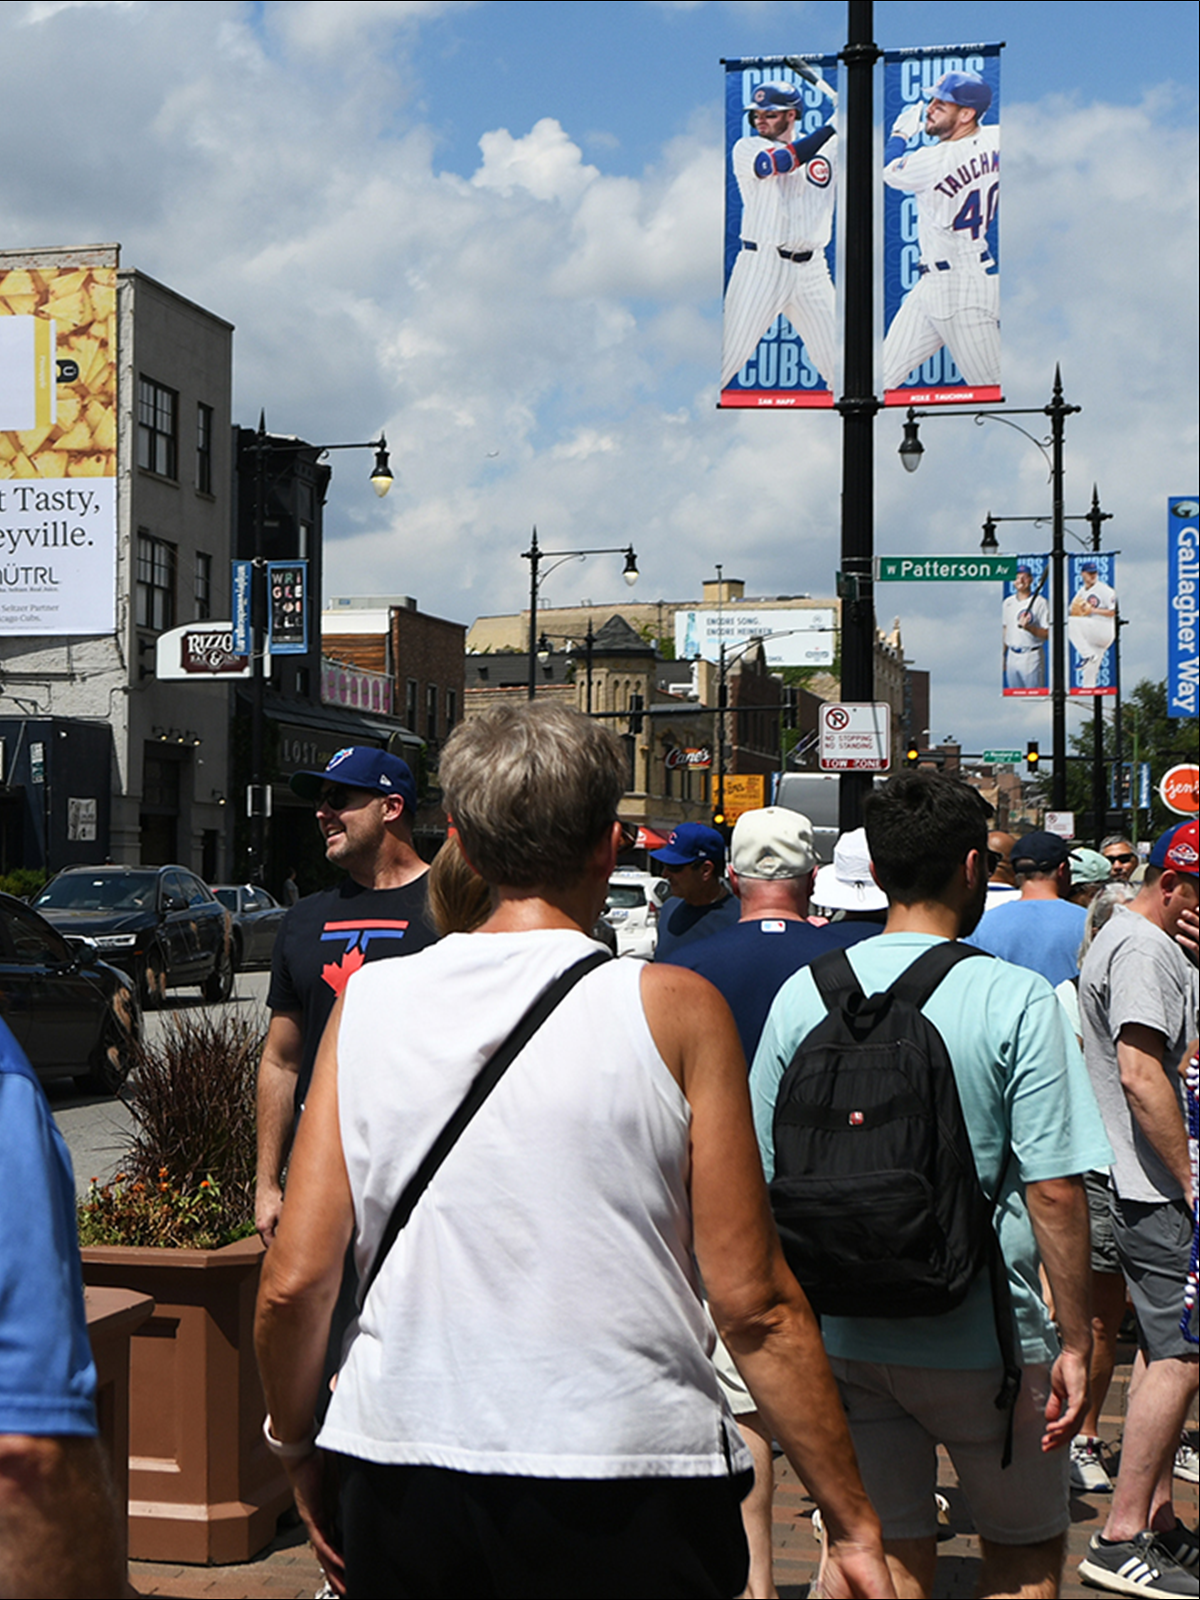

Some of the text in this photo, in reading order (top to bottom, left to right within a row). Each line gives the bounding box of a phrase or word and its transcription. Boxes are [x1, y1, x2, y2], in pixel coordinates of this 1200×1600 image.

[13, 486, 101, 518] Tasty,
[886, 560, 1010, 578] W Patterson Av
[1, 604, 28, 613] Seltzer
[29, 604, 59, 612] Partner
[1172, 527, 1199, 713] Gallagher Way
[665, 747, 712, 770] Cane's
[824, 758, 882, 768] TOW ZONE
